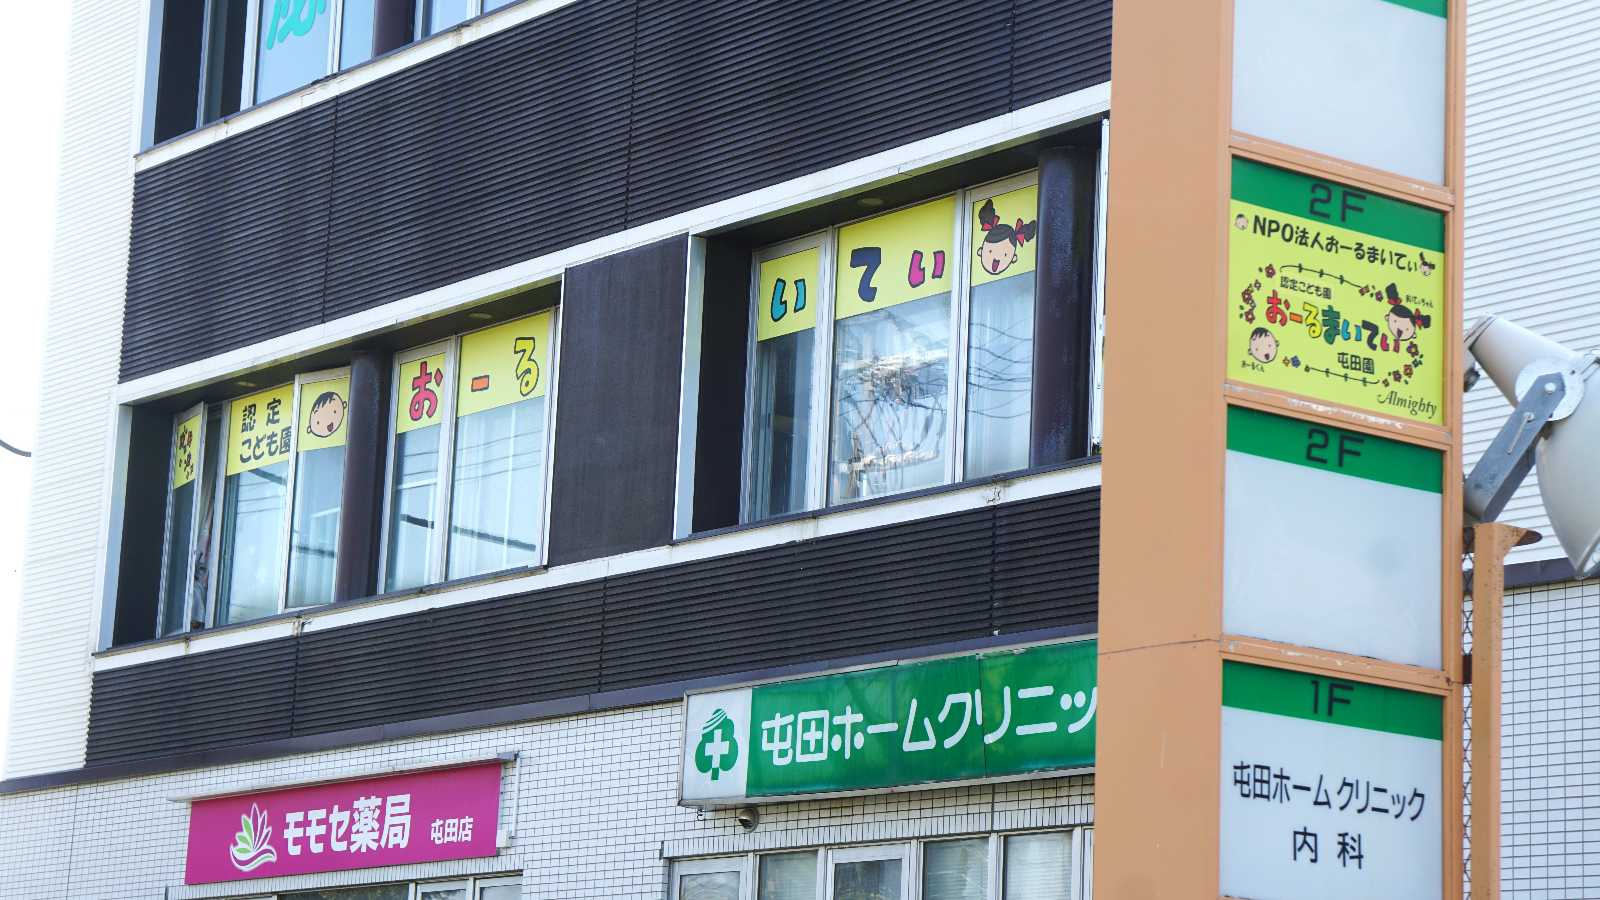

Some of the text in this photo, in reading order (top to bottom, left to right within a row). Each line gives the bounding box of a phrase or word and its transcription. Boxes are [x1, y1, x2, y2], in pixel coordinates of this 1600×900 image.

[1280, 276, 1331, 299] 認定こども園
[1337, 352, 1374, 374] 屯田園
[1377, 391, 1437, 419] Almighty
[240, 426, 292, 463] こども園
[1311, 680, 1354, 716] 1F
[283, 793, 474, 854] モモセ薬局 屯田店
